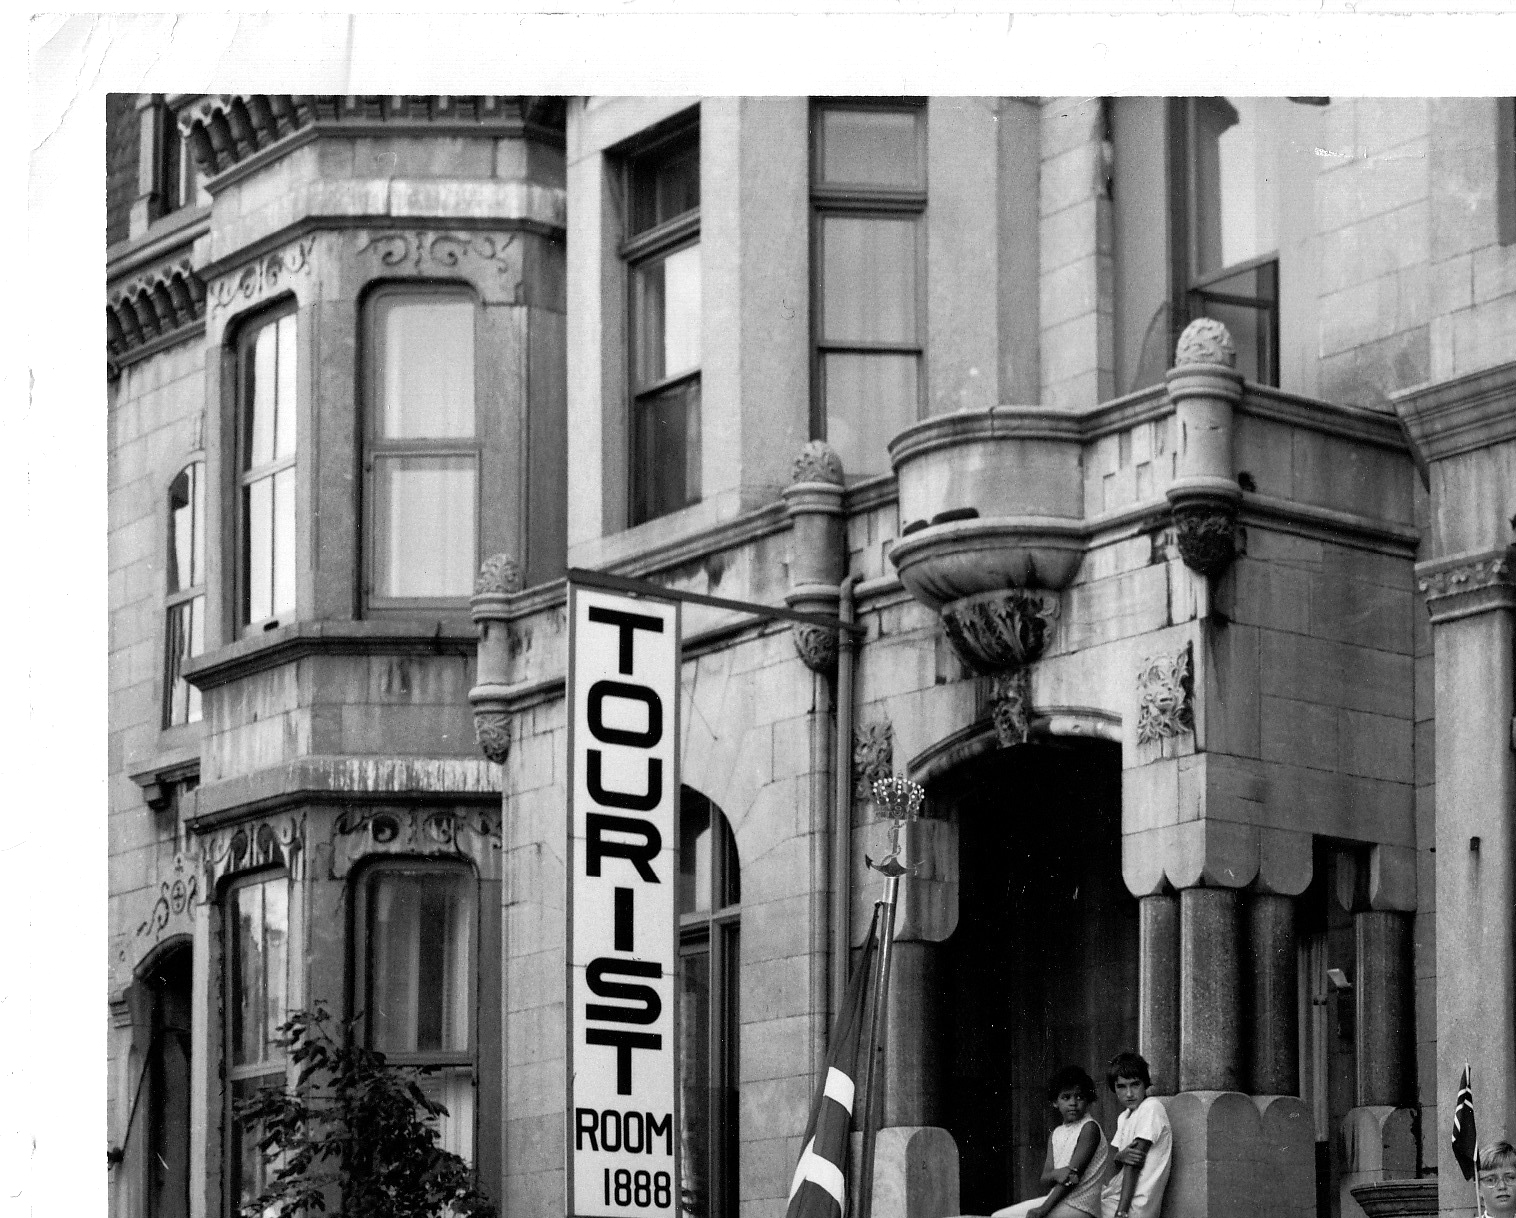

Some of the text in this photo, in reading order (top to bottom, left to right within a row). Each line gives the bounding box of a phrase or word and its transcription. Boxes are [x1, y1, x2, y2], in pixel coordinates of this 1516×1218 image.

[585, 605, 664, 1096] TOURIST
[575, 1107, 673, 1157] ROOM
[604, 1167, 672, 1209] 1888
